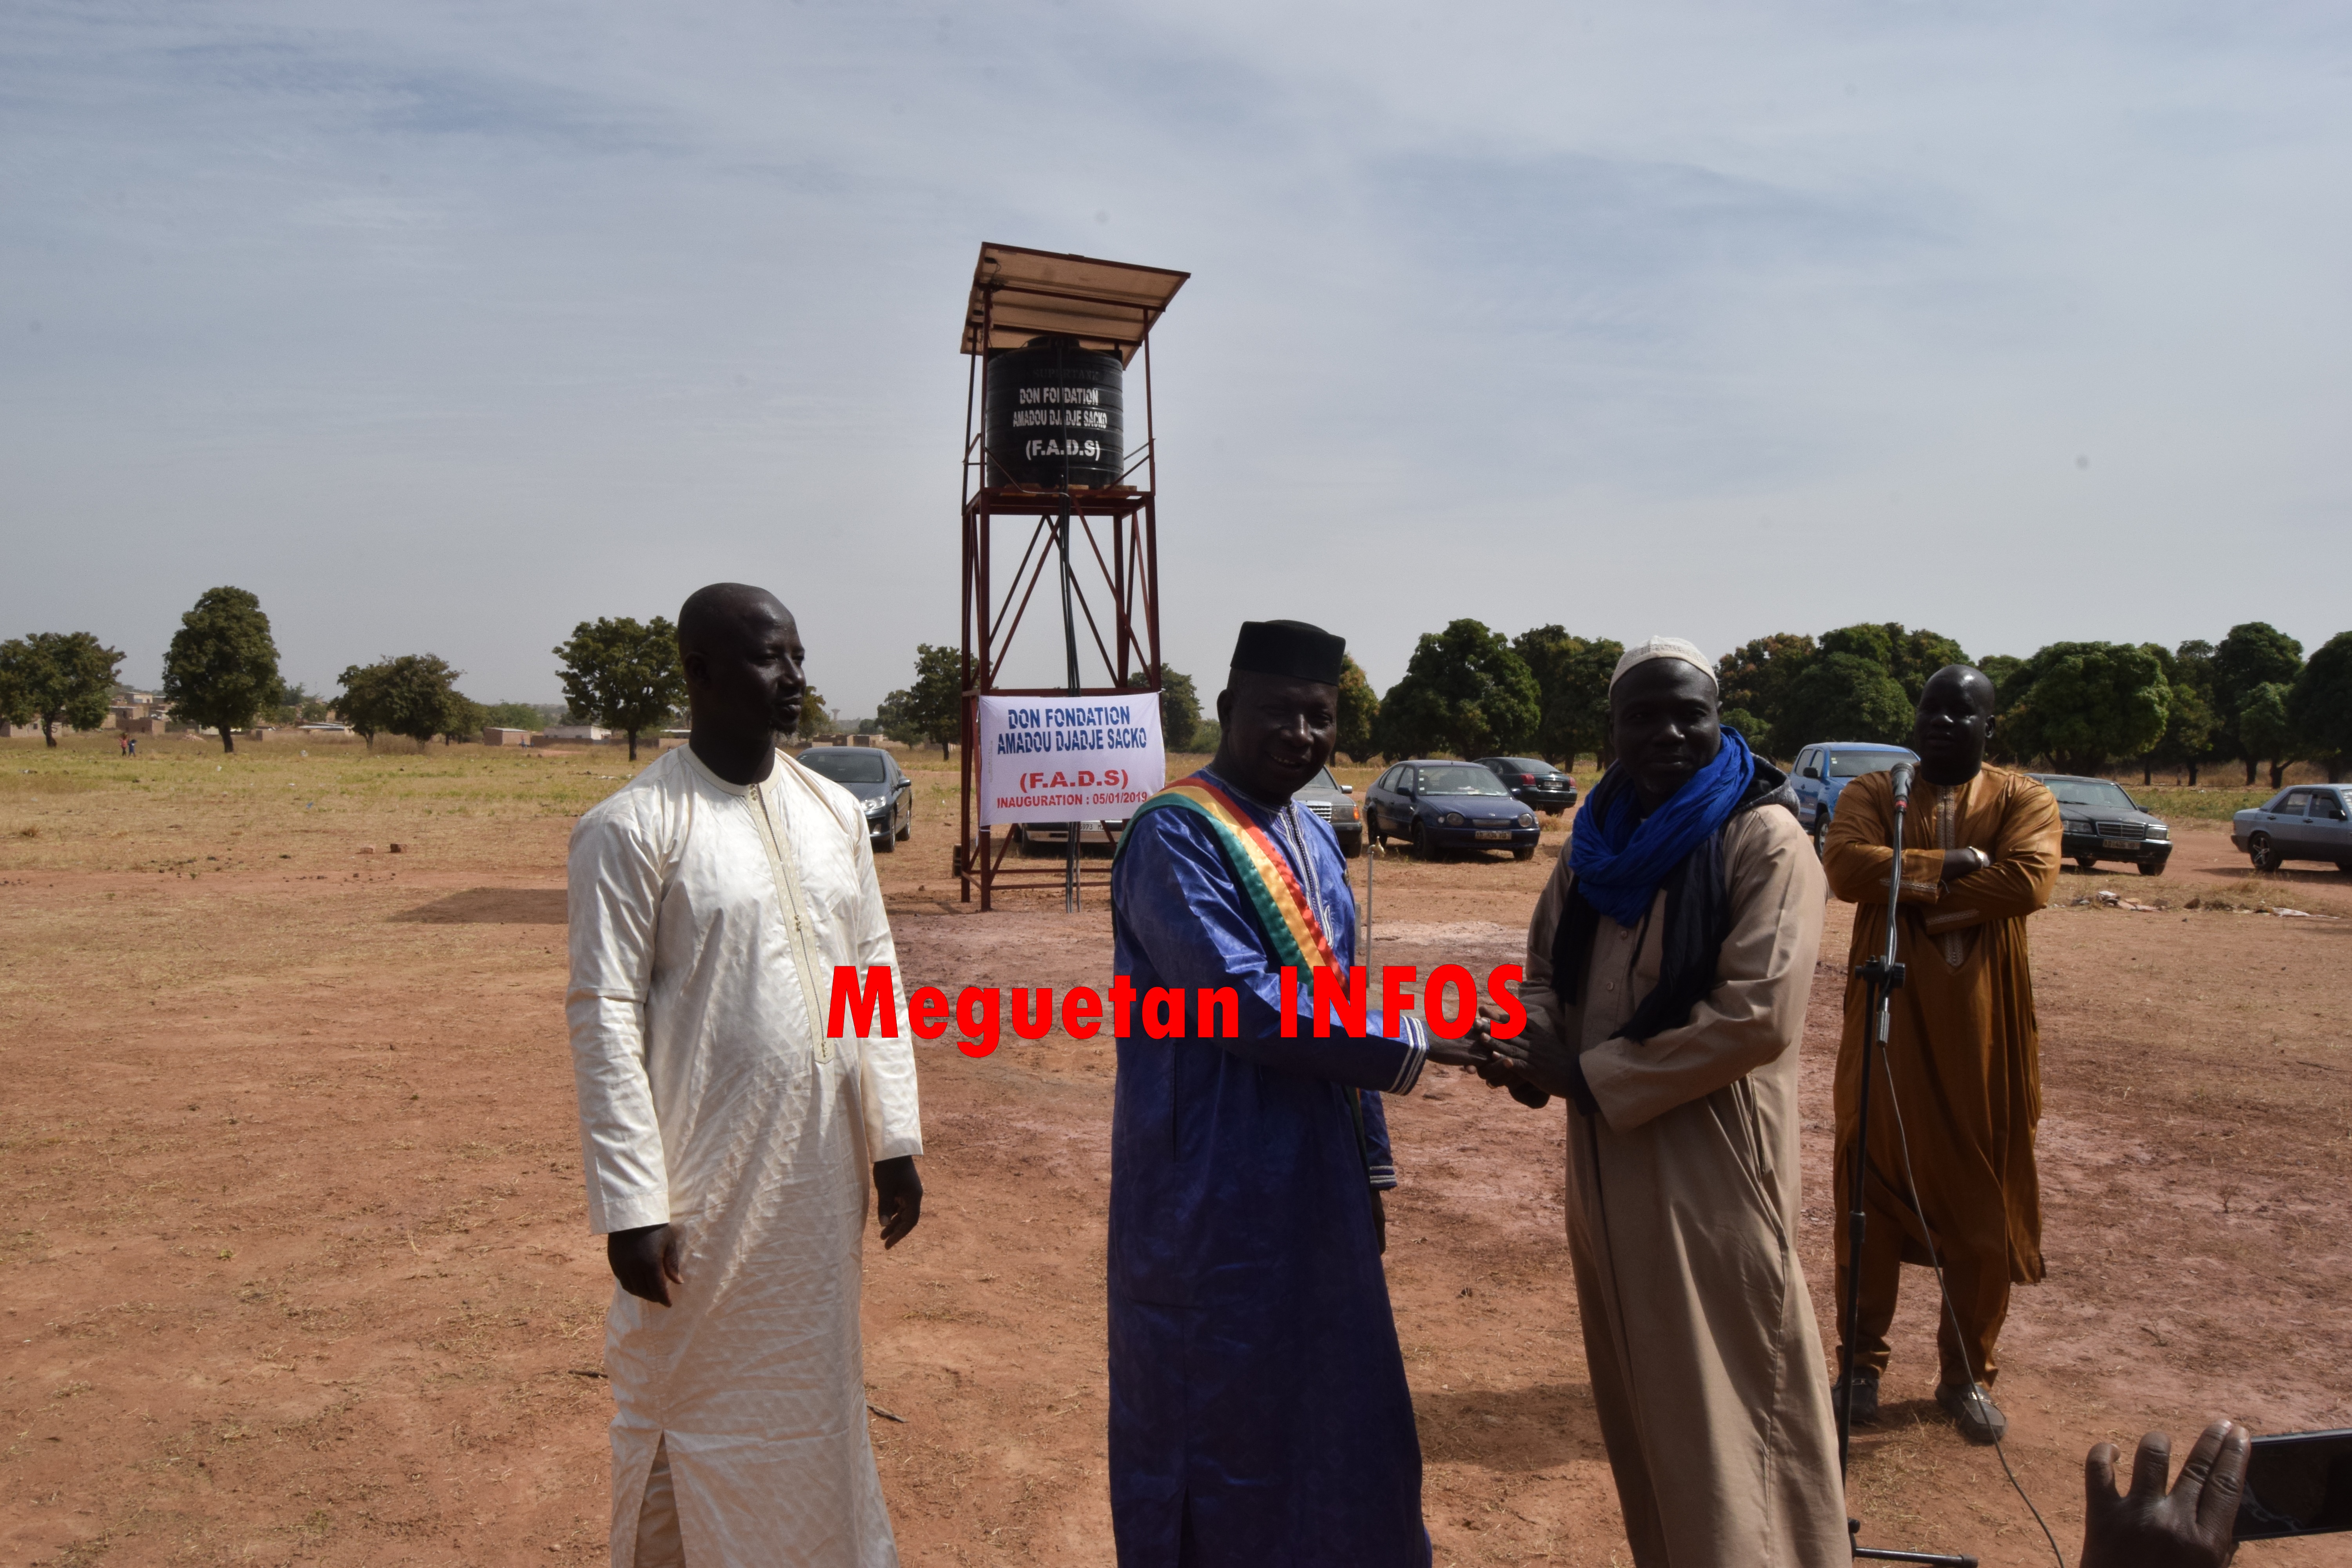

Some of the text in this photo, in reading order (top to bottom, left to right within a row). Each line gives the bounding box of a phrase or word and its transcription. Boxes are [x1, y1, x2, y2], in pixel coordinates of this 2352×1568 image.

[1020, 387, 1040, 404] DON
[1013, 409, 1107, 429] AMADOU DJDJE SACKO
[1025, 439, 1100, 461] (F.A.D.S)
[1008, 706, 1130, 729] DON FONDATION
[998, 727, 1147, 755] AMADOU DJADJE SACKO
[1020, 769, 1129, 793] (F.A.D.S)
[997, 794, 1083, 808] INAUGURATION
[1093, 791, 1147, 804] 05/01/2019
